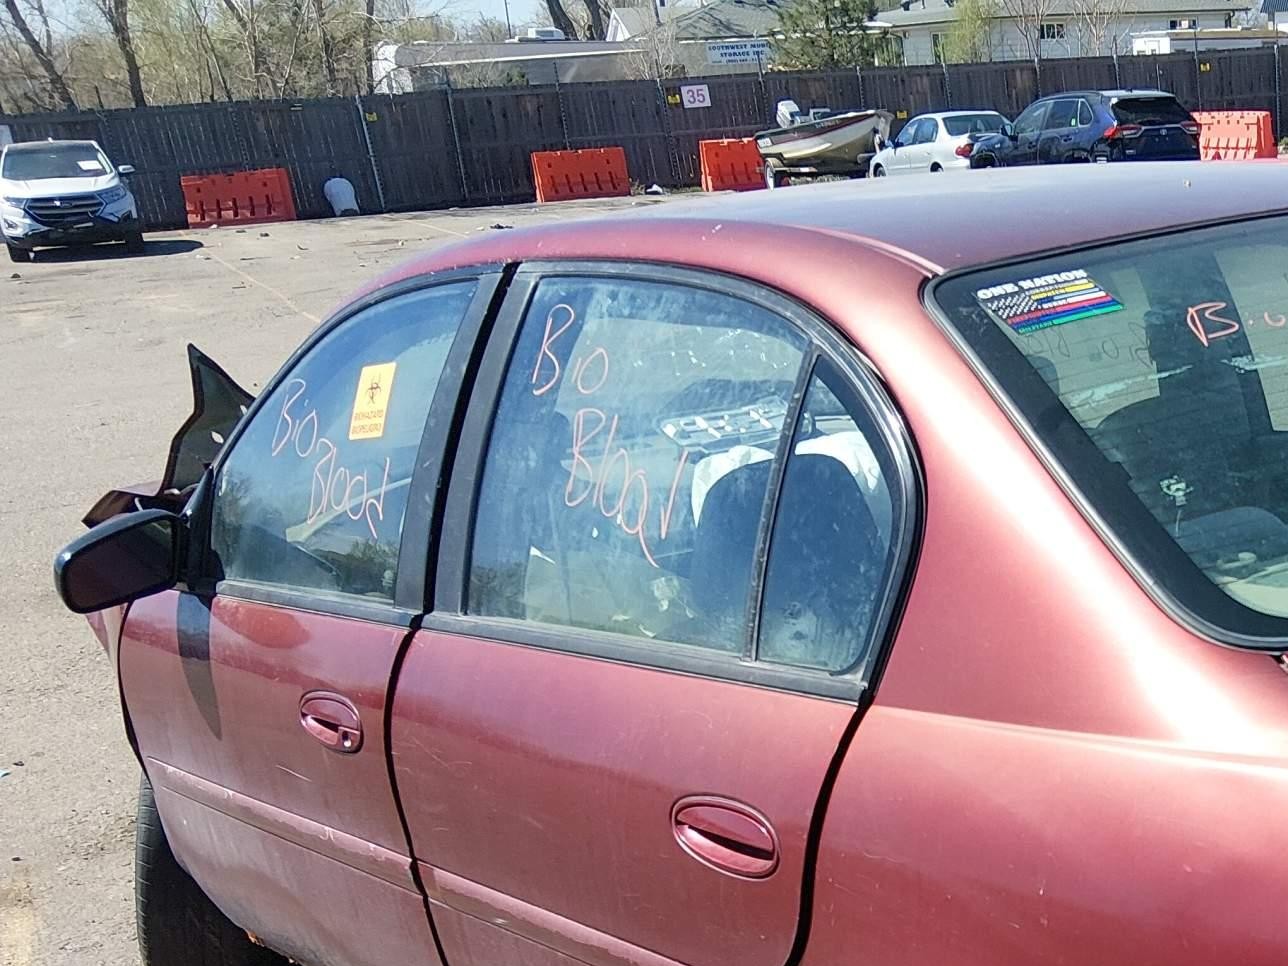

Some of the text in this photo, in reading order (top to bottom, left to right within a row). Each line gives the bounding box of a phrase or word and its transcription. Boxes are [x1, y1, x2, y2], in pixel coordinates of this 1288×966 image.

[708, 43, 748, 51] SOUTHWEST
[720, 50, 750, 58] STORAGE
[686, 88, 706, 105] 35
[977, 282, 1020, 300] ONE
[1018, 268, 1088, 290] NATION
[306, 437, 391, 540] Blood
